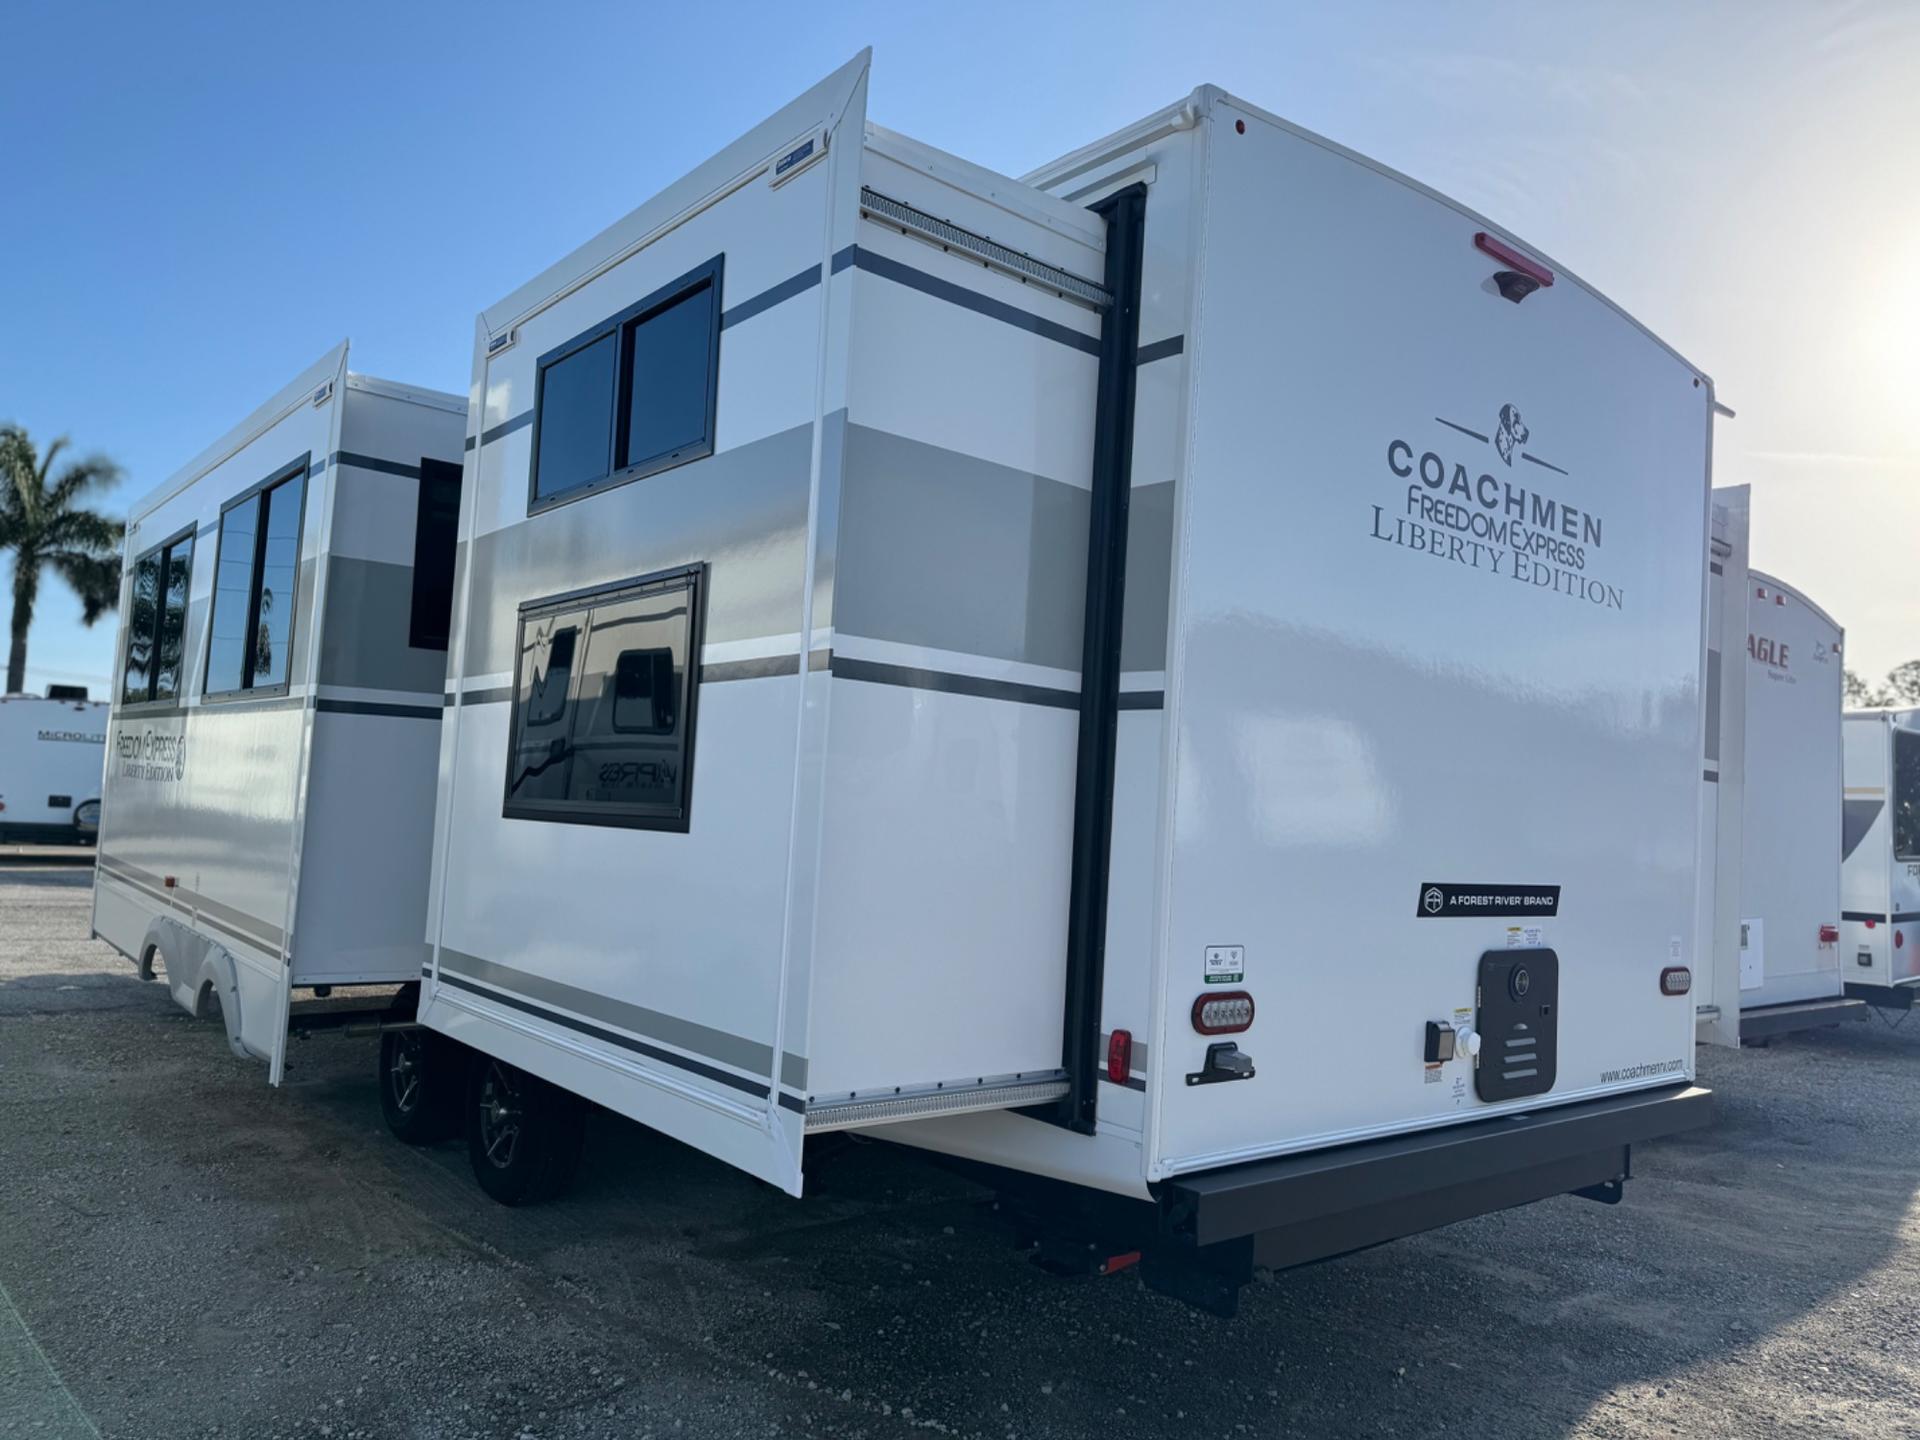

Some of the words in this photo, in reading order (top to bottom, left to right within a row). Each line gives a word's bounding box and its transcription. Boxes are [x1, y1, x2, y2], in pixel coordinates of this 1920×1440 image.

[1387, 439, 1602, 548] COACHMEN
[1370, 505, 1505, 574] LIBERTY
[1511, 550, 1625, 611] EDITION
[1449, 895, 1457, 906] A
[1458, 896, 1495, 906] FOREST
[1495, 896, 1522, 906] RIVER
[1524, 896, 1554, 906] BRAND
[1600, 1058, 1684, 1084] www.coachmenrv.com
